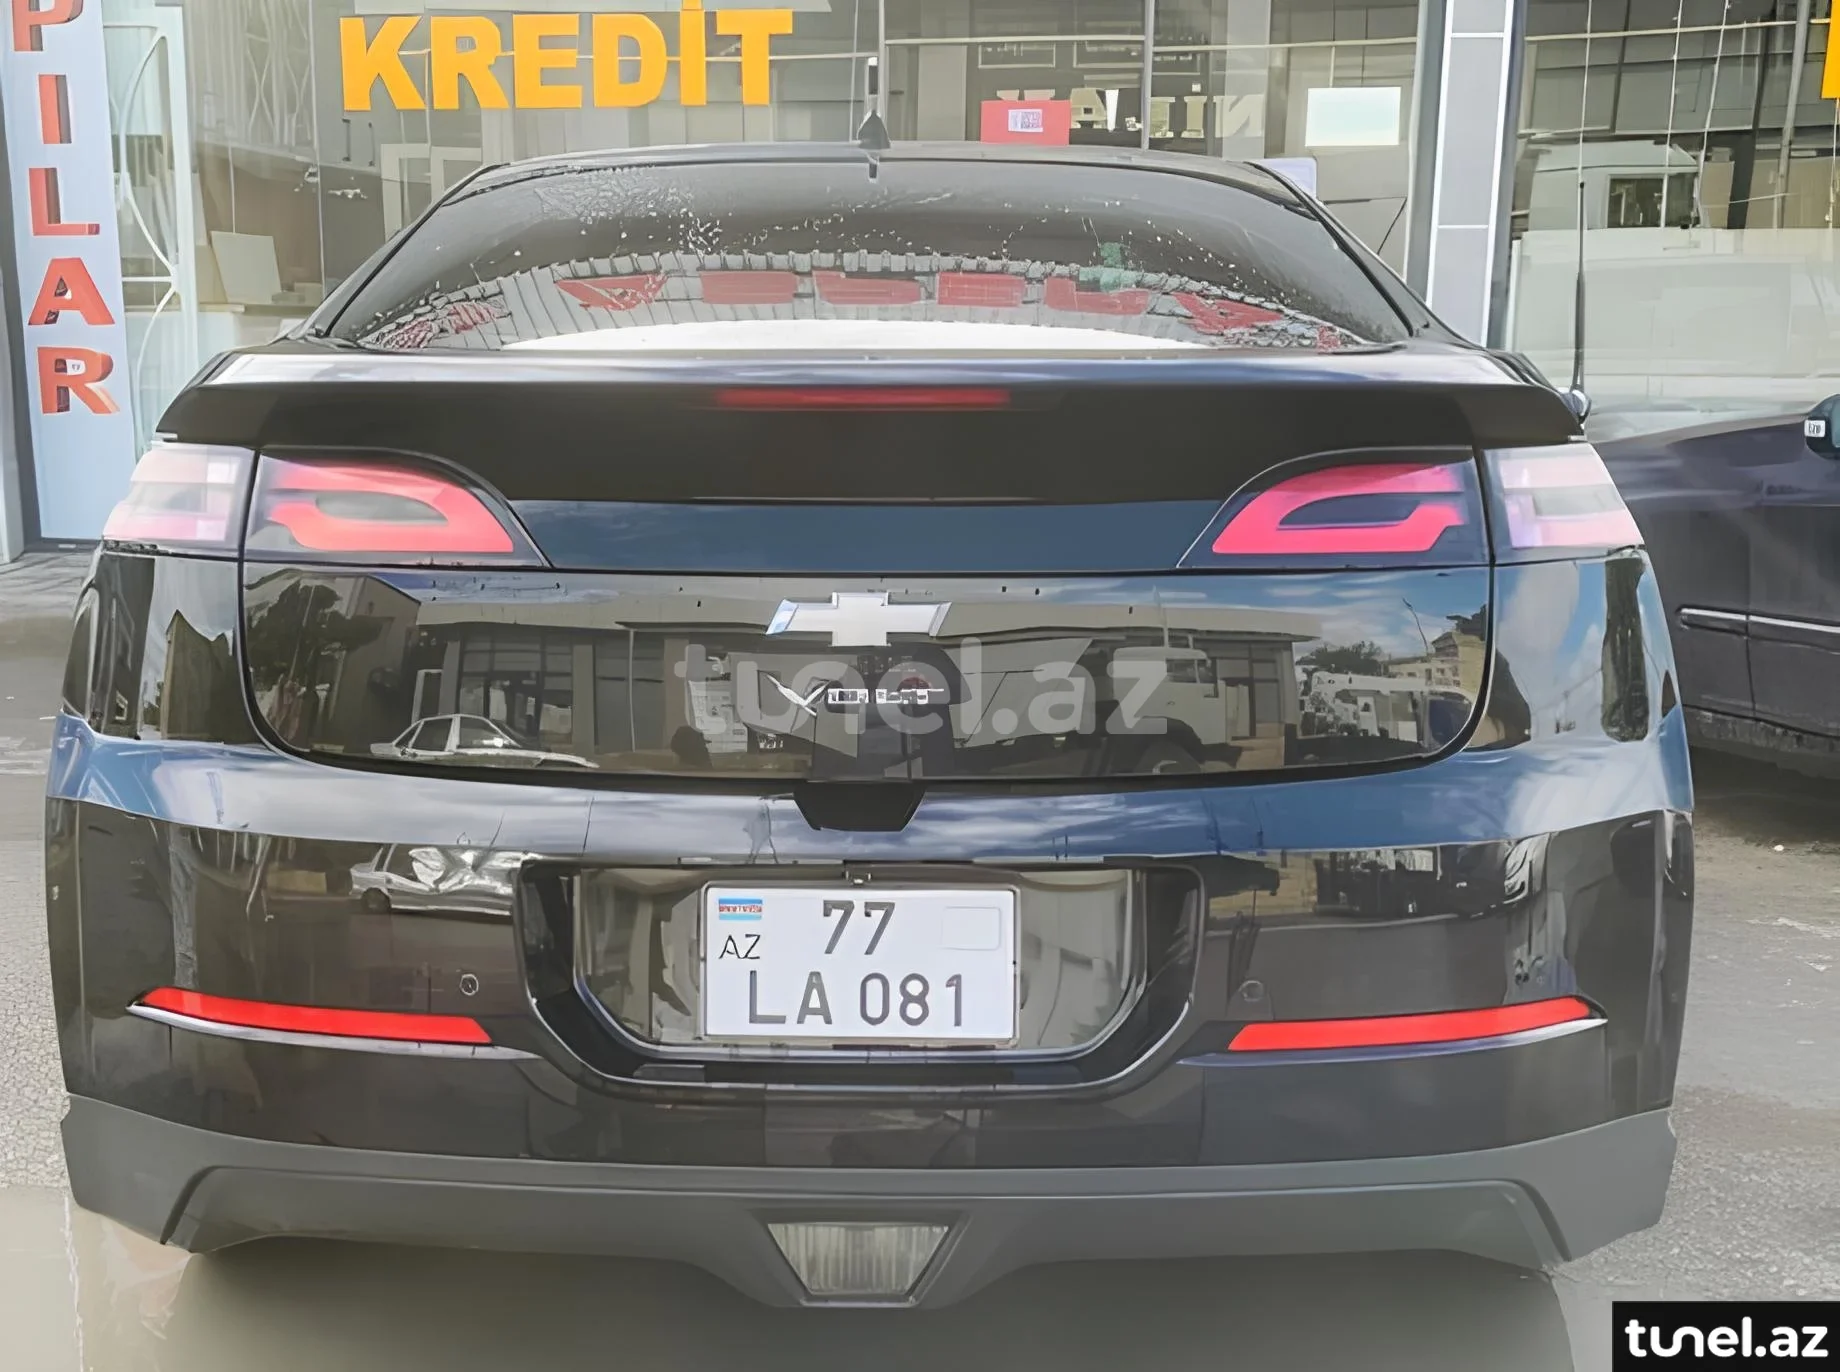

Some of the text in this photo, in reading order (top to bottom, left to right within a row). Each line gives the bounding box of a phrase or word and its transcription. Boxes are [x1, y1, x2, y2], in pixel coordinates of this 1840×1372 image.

[339, 0, 794, 111] KREDİT
[718, 933, 762, 960] AZ
[822, 899, 896, 956] 77
[748, 969, 963, 1028] LA 081
